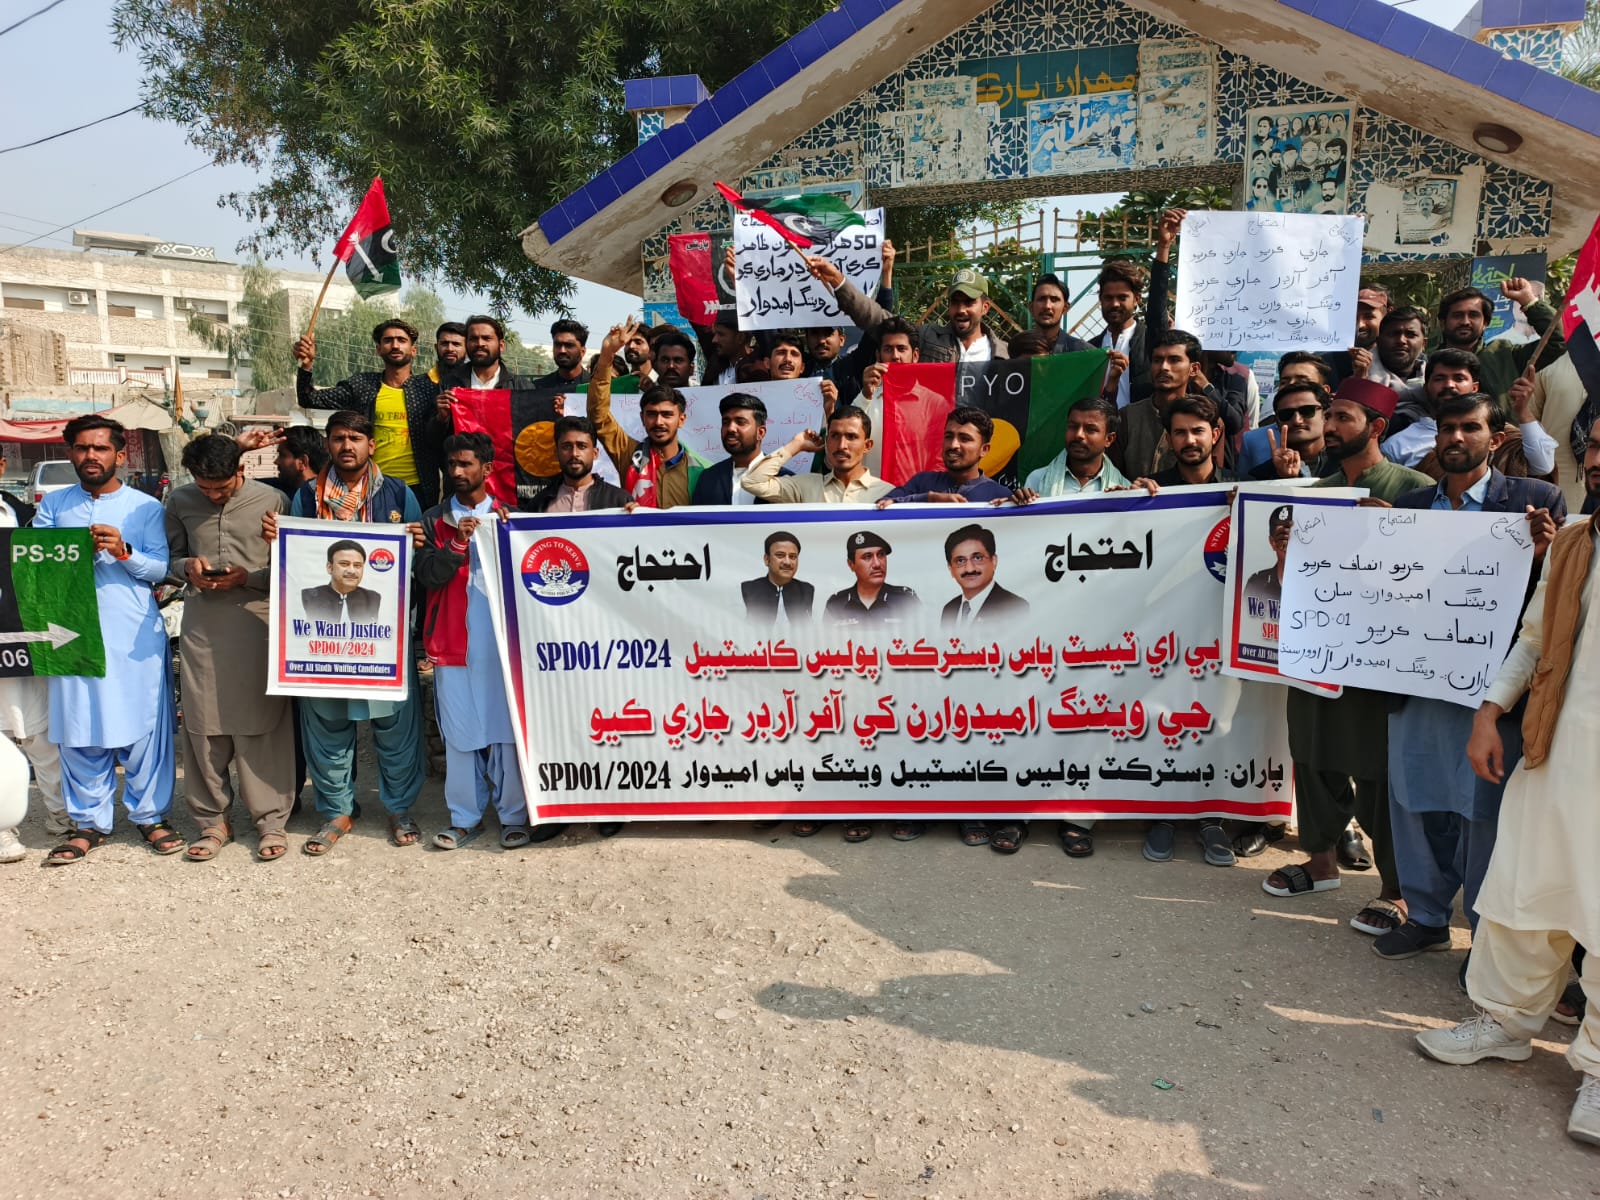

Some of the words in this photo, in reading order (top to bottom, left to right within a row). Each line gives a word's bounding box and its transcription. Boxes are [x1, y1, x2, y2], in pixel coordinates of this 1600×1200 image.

[961, 371, 1025, 398] PYO
[1378, 509, 1417, 537] احتجاج
[12, 544, 80, 563] PS-35
[526, 541, 553, 570] STRIVING
[552, 540, 565, 550] TO
[563, 544, 584, 569] SERVE
[616, 543, 713, 593] احتجاج
[1044, 528, 1154, 584] احتجاج
[1338, 553, 1383, 572] انصاف
[1443, 554, 1500, 577] انصاف
[1248, 595, 1265, 617] We
[1314, 581, 1353, 602] سان
[293, 618, 312, 637] We
[315, 619, 347, 638] Want
[350, 621, 392, 640] Justice
[1423, 617, 1494, 650] انصاف
[308, 640, 376, 656] SPD01/2024
[536, 637, 673, 673] SPD01/2024
[805, 638, 880, 681] پوليس
[1008, 635, 1055, 679] پاس
[1061, 630, 1137, 672] ٽيسٽ
[1146, 630, 1175, 675] اي
[1242, 646, 1257, 658] Over
[1257, 647, 1266, 659] All
[289, 662, 305, 672] Over
[305, 663, 314, 672] All
[315, 663, 332, 672] Sindh
[334, 664, 357, 674] Waiting
[357, 664, 391, 674] Candidates
[663, 696, 731, 748] جاري
[741, 688, 796, 740] آرڊر
[803, 688, 845, 740] آفر
[906, 694, 1037, 742] اميدوارن
[1046, 685, 1145, 739] ويٽنگ
[1158, 698, 1213, 748] جي
[538, 759, 672, 792] SPD01/2024
[680, 758, 759, 789] اميدوار
[764, 758, 806, 792] پاس
[811, 753, 883, 789] ويٽنگ
[1015, 758, 1091, 791] پوليس
[1223, 756, 1285, 793] پاران:
